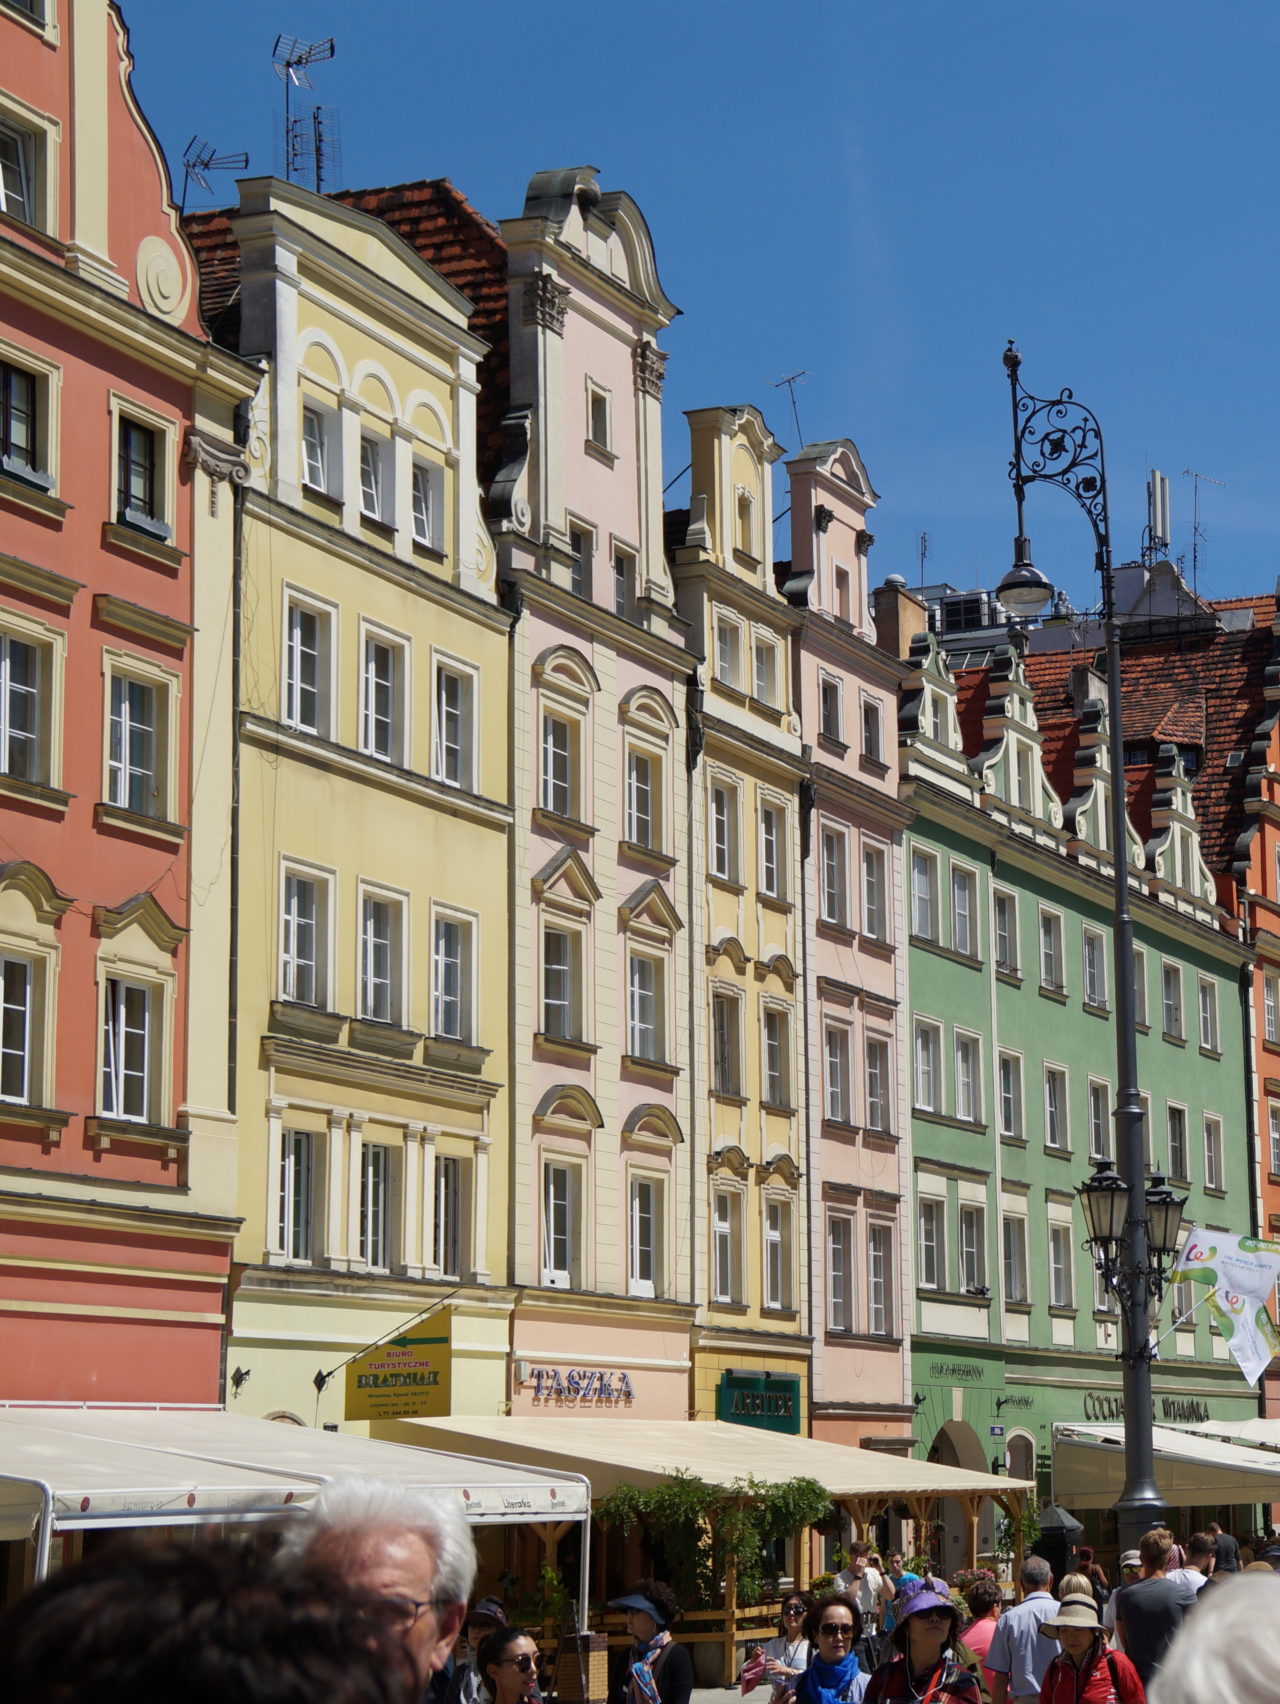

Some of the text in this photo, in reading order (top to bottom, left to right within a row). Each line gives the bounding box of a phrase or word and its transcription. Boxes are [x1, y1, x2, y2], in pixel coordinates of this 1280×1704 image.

[368, 1361, 431, 1370] TURYSTYCZNE
[529, 1368, 635, 1399] TASZKA
[731, 1390, 793, 1417] ARBITER
